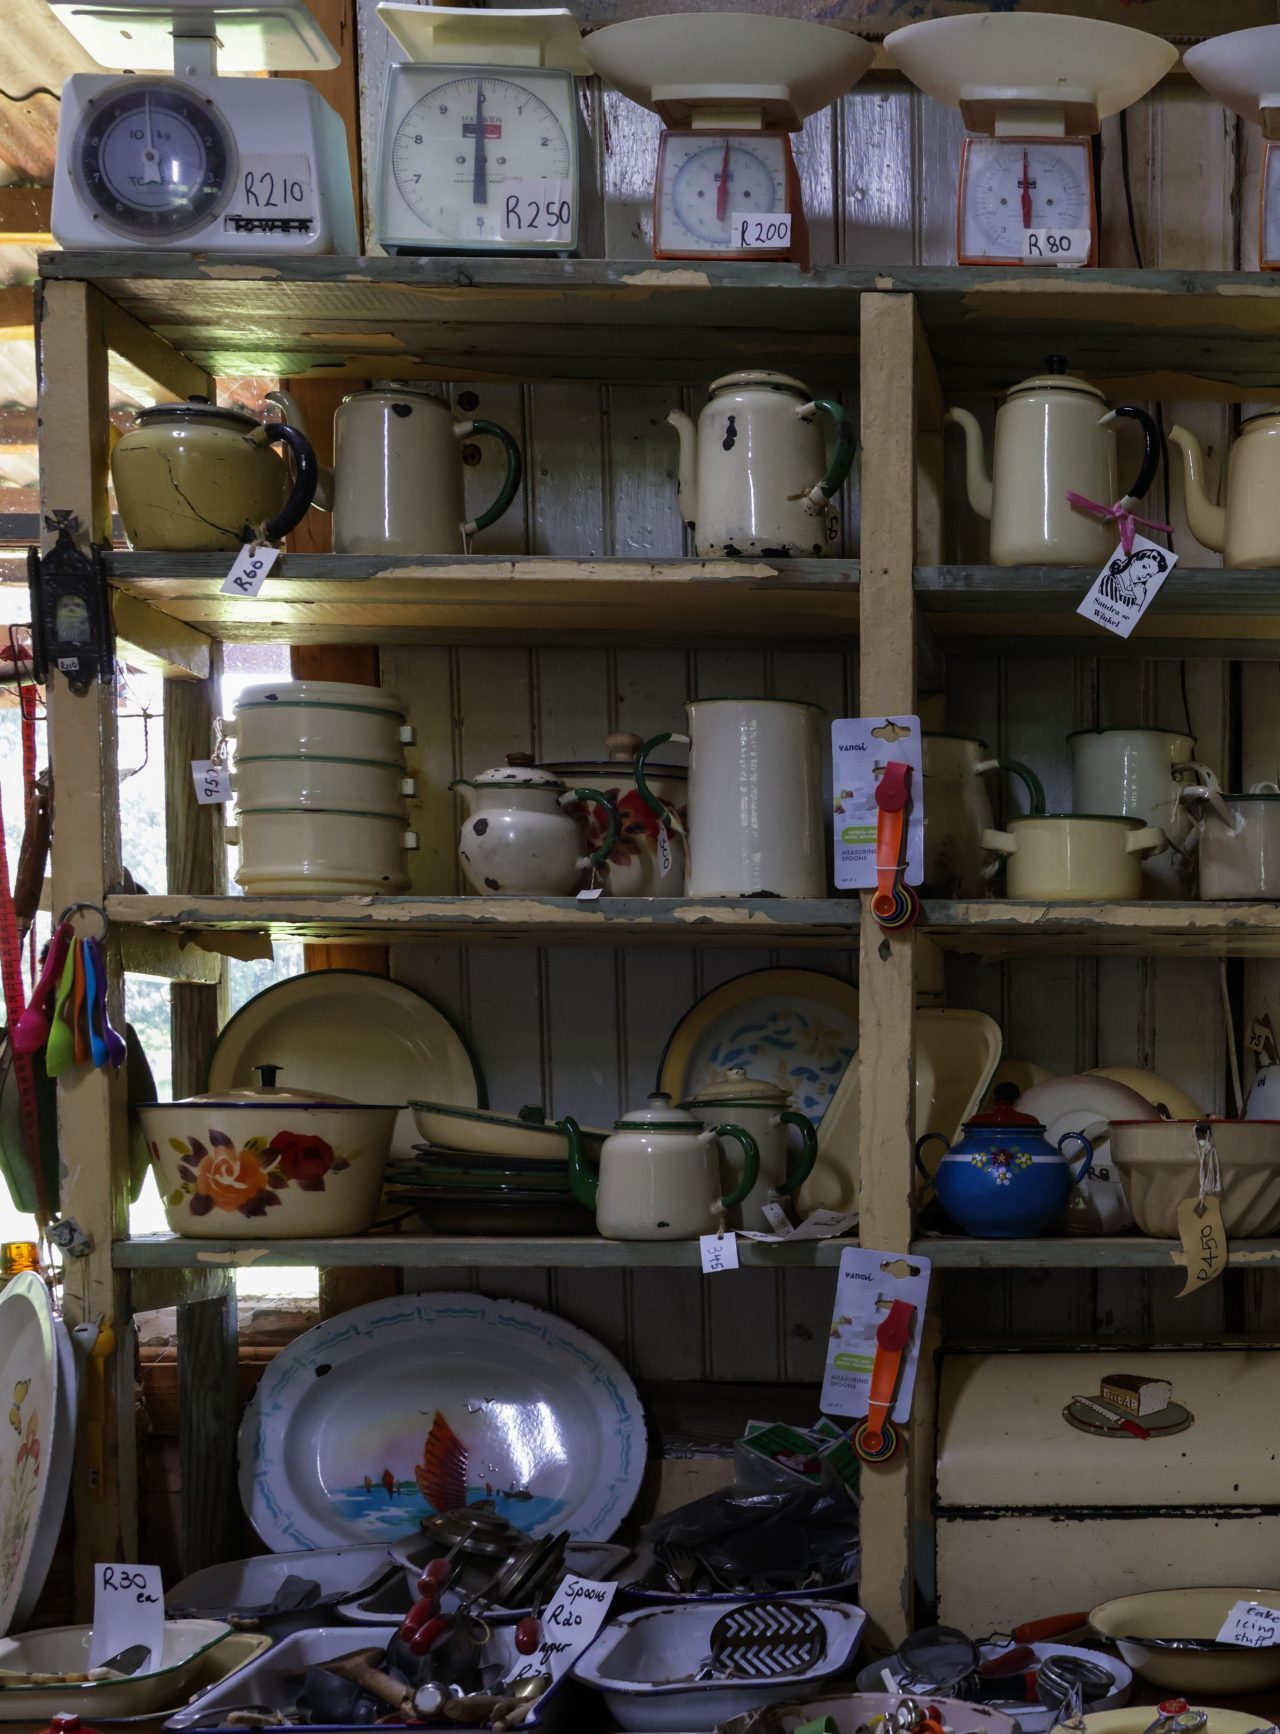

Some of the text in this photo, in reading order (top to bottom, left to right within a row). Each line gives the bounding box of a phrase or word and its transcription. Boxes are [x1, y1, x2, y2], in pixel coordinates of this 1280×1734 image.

[439, 105, 448, 114] 9
[129, 129, 145, 140] 10
[414, 135, 423, 144] 8
[540, 137, 549, 147] 2
[413, 174, 421, 183] 7
[245, 172, 303, 207] R210
[506, 195, 571, 229] R250
[476, 217, 485, 227] 5
[741, 220, 788, 247] R200
[1029, 233, 1072, 256] R80
[233, 560, 263, 592] R60
[1093, 597, 1120, 616] Sandra
[1094, 609, 1120, 628] Winkel
[204, 769, 220, 797] 950
[707, 1246, 725, 1269] 345
[1197, 1225, 1219, 1280] R450
[830, 1381, 857, 1390] SPOONS
[831, 1375, 869, 1385] MEASURING
[103, 1566, 147, 1591] R30
[136, 1592, 159, 1604] ea
[565, 1580, 607, 1606] Spoons
[547, 1604, 582, 1627] R20
[1234, 1632, 1264, 1647] stuff
